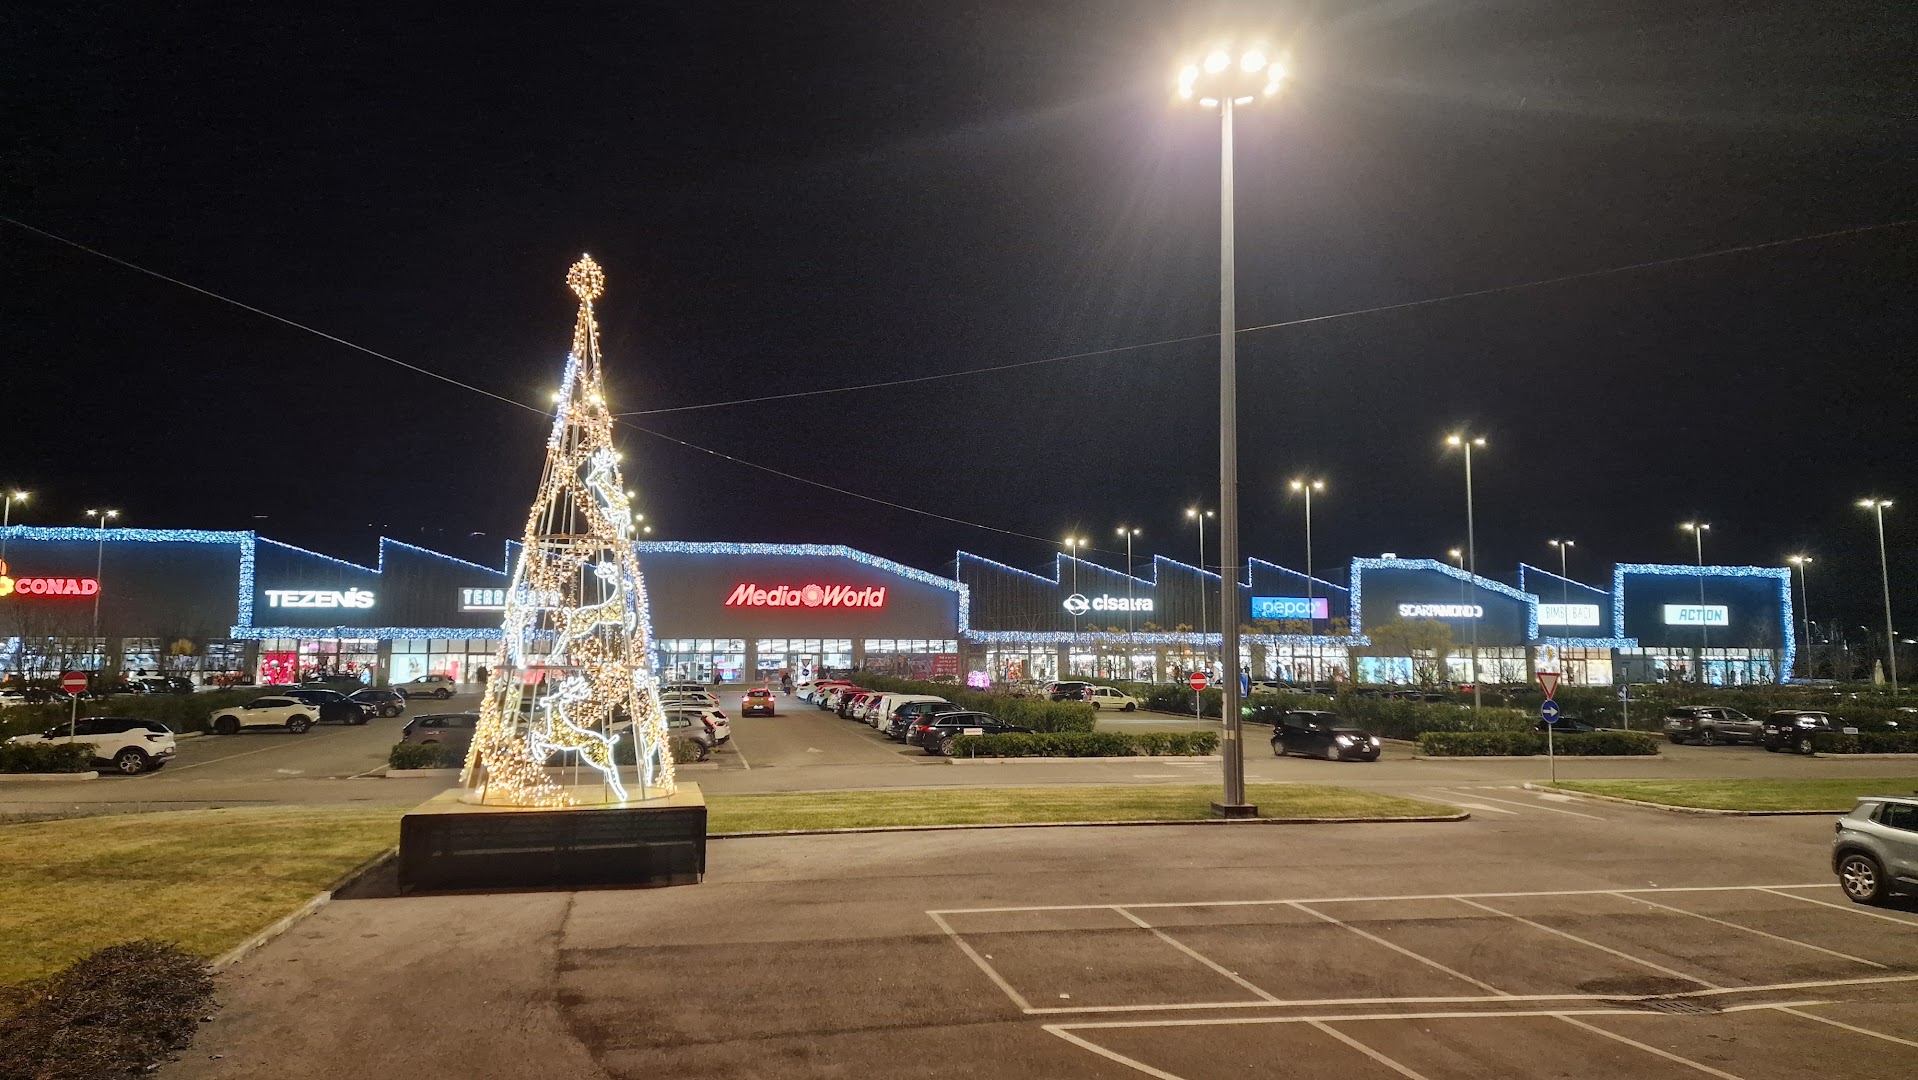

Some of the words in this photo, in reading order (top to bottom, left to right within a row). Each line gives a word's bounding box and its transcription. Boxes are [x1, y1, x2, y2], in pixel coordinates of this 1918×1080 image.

[15, 579, 98, 595] CONAD
[725, 583, 800, 606] Media
[822, 585, 886, 607] World
[463, 589, 560, 606] TERRNOVA
[1092, 593, 1154, 612] cisalfa
[1262, 601, 1316, 617] pepco
[1679, 609, 1723, 621] ACTION
